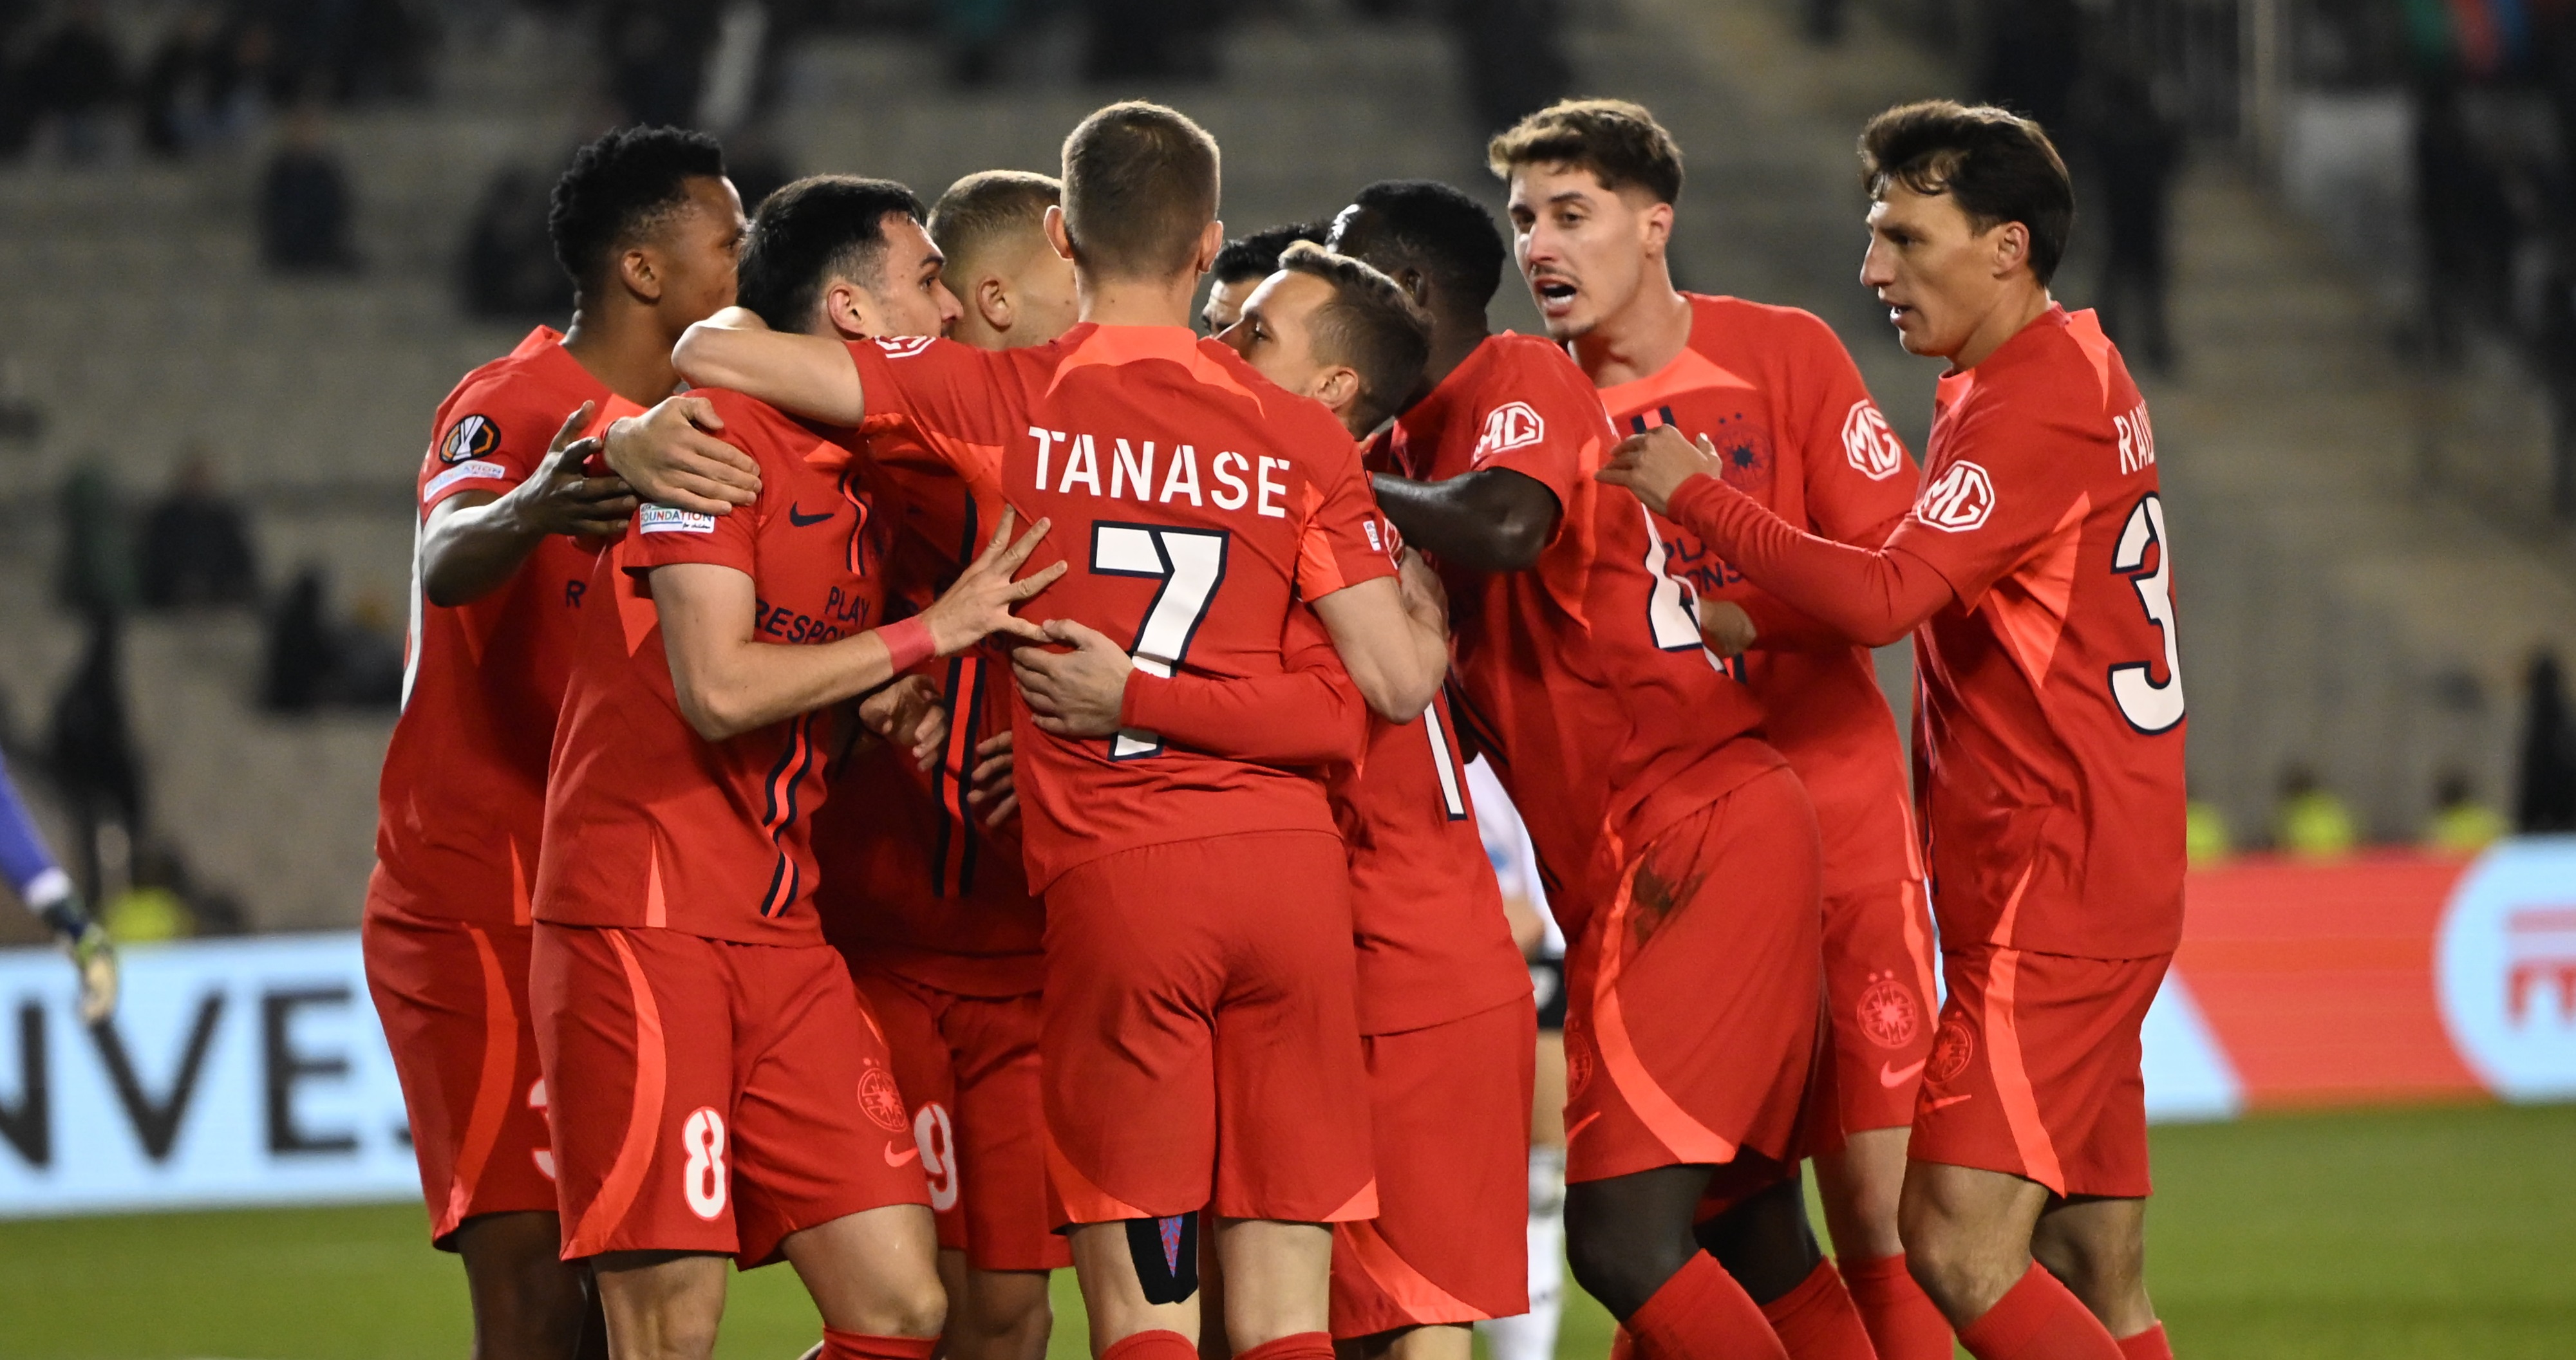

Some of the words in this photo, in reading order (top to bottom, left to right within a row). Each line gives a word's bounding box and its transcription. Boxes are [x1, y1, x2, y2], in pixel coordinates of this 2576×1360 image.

[1028, 426, 1290, 518] TANASE
[1849, 407, 1897, 472] MG
[1924, 466, 1988, 525] MG
[825, 586, 870, 628] PLAY
[1088, 520, 1230, 762] 7
[2107, 490, 2185, 735] 3
[682, 1106, 726, 1220] 8
